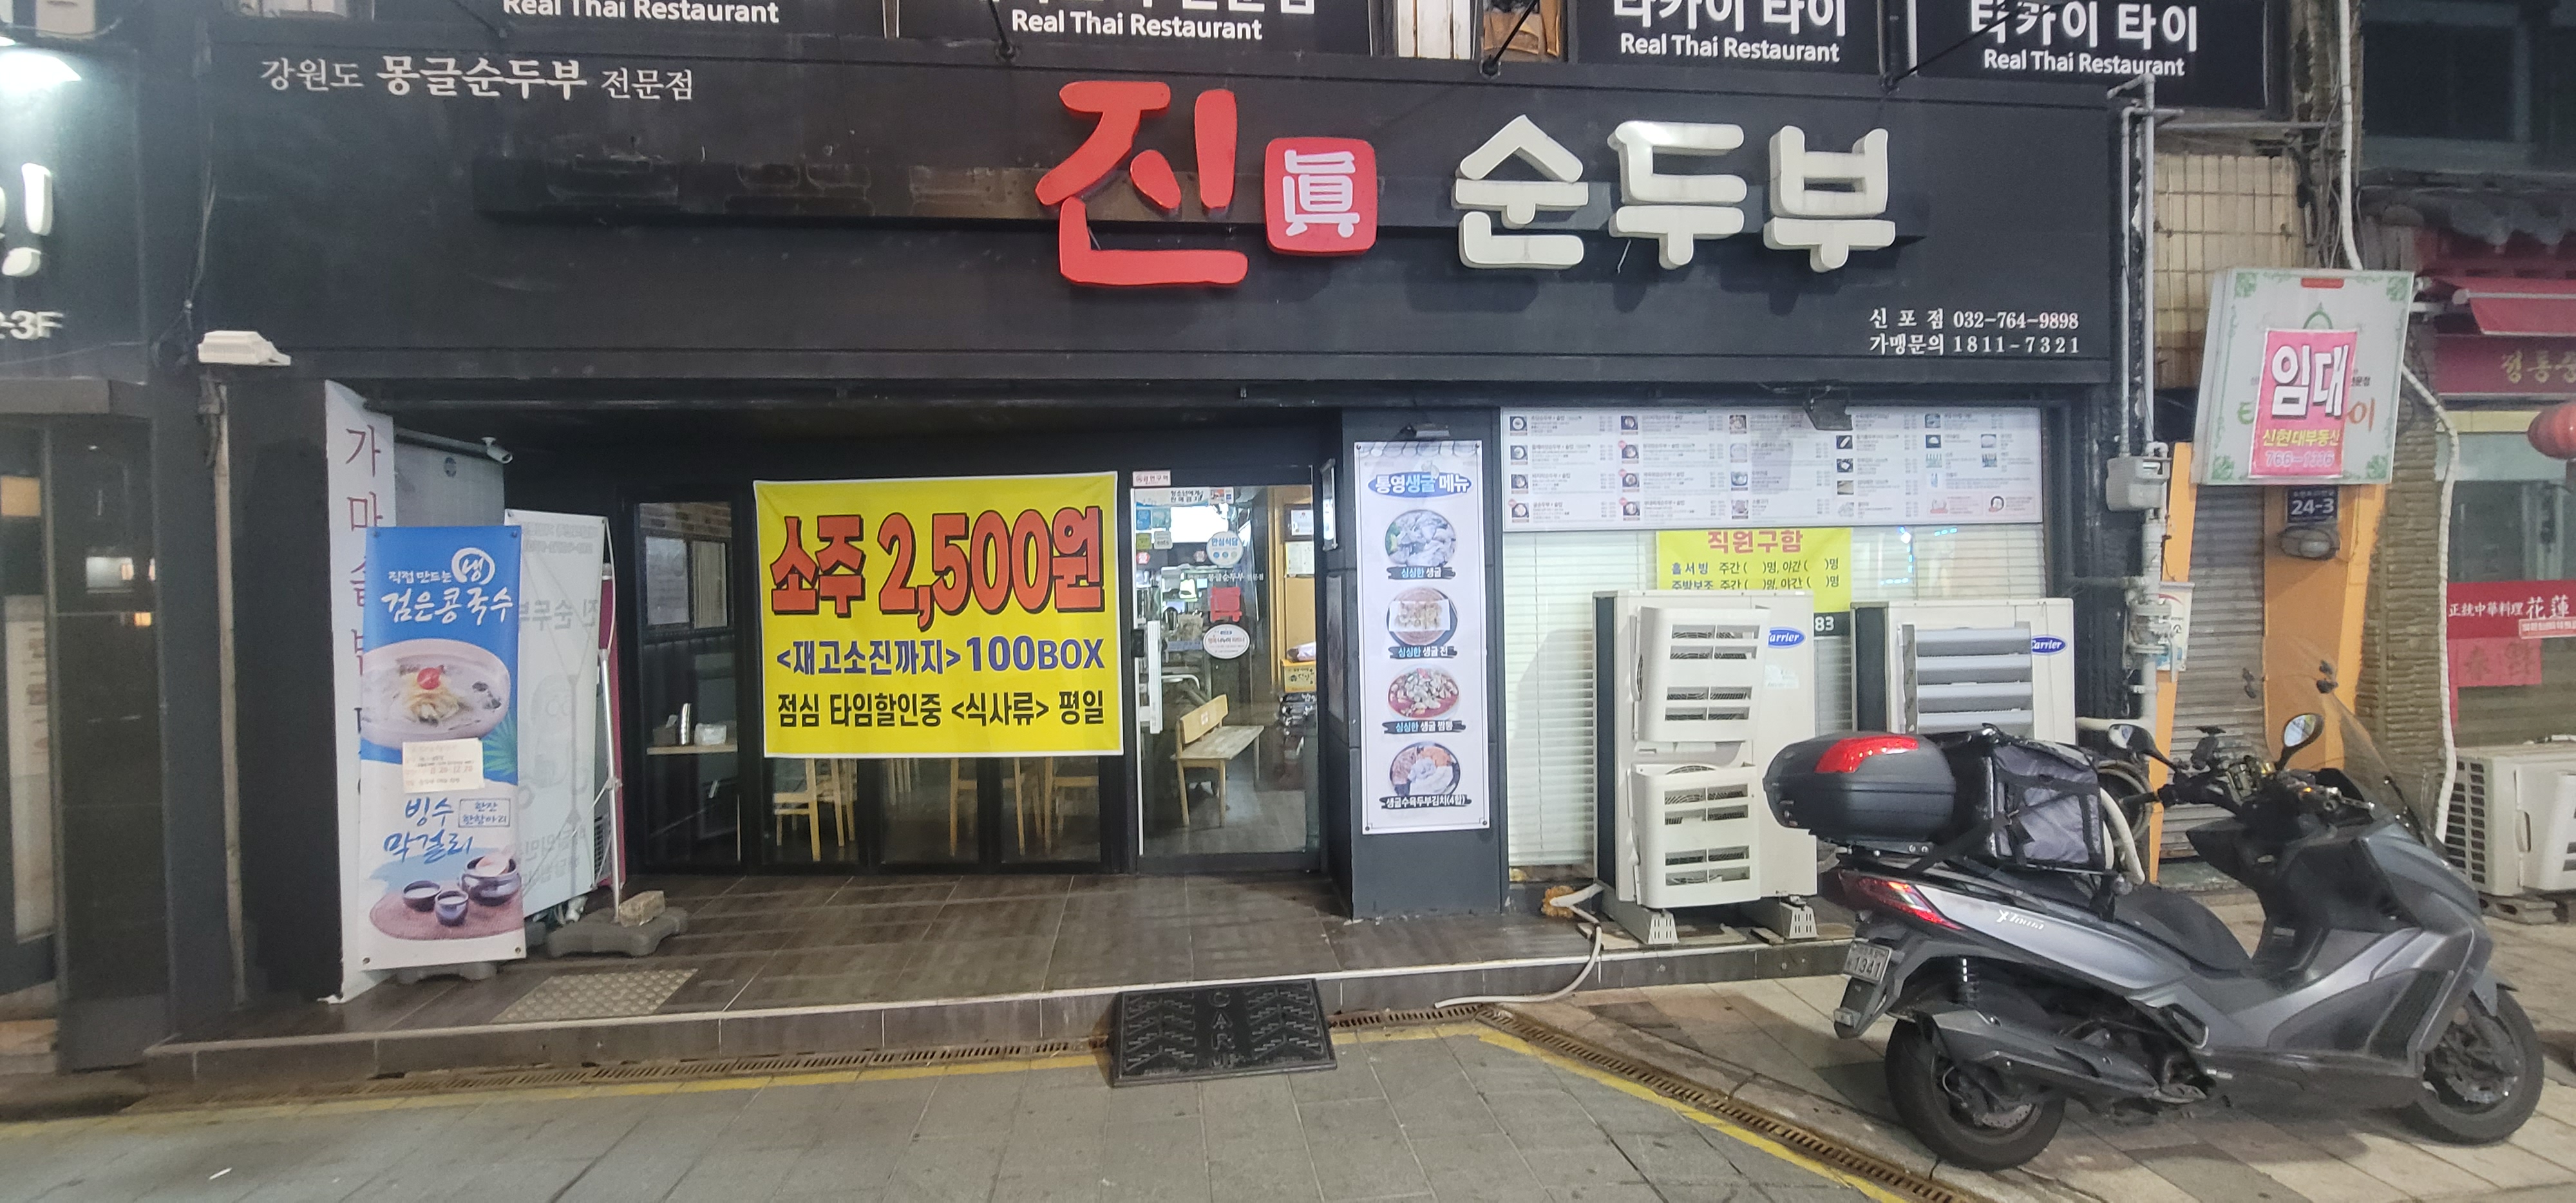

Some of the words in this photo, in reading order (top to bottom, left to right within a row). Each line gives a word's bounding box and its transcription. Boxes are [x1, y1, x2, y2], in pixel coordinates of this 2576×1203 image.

[504, 0, 554, 17] Real
[571, 0, 627, 19] Thai
[634, 0, 779, 23] Restaurant
[1012, 10, 1065, 33] Real
[1070, 11, 1124, 35] Thai
[1130, 17, 1262, 40] Restaurant
[2118, 3, 2197, 52] 타이
[1620, 32, 1667, 55] Real
[1671, 35, 1718, 57] Thai
[1724, 37, 1840, 62] Restaurant
[1984, 48, 2027, 70] Real
[2030, 50, 2074, 72] Thai
[2079, 53, 2185, 77] Restaurant
[261, 58, 364, 92] 강원도
[376, 55, 587, 100] 몽글순두부
[600, 68, 694, 100] 전문점
[1035, 81, 1248, 286] 진
[1451, 114, 1896, 273] 순두부
[1953, 310, 2079, 330] 032-764-9898
[1870, 334, 1944, 355] 가맹문의
[1953, 336, 2079, 354] 1811-7321
[2271, 345, 2349, 419] 임대
[2262, 428, 2340, 447] 신현대부동산
[1375, 473, 1435, 494] 통영생굴
[1439, 474, 1470, 493] 메뉴
[2291, 498, 2334, 516] 24-3
[1707, 529, 1803, 554] 직원구함
[388, 570, 415, 585] 직접
[416, 570, 452, 584] 만드는
[770, 515, 866, 618] 소주
[877, 506, 1105, 632] 2,500원
[1401, 567, 1425, 578] 싱싱한
[1426, 567, 1442, 578] 생굴
[381, 585, 513, 627] 검은콩국수
[2449, 600, 2523, 617] 正統中華料理
[1768, 632, 1799, 643] arrier
[777, 638, 961, 676] <재고소진까지>
[966, 635, 1106, 672] 100BOX
[1397, 647, 1421, 658] 싱싱한
[1423, 646, 1438, 657] 생굴
[777, 694, 820, 728] 점심
[829, 692, 942, 728] 타임할인중
[951, 691, 1050, 727] <식사류>
[1059, 690, 1105, 726] 평일
[1396, 722, 1419, 732] 싱싱한
[1420, 721, 1436, 732] 생굴
[405, 797, 454, 827] 빙수
[383, 828, 473, 865] 막걸리
[1855, 956, 1882, 978] 1341
